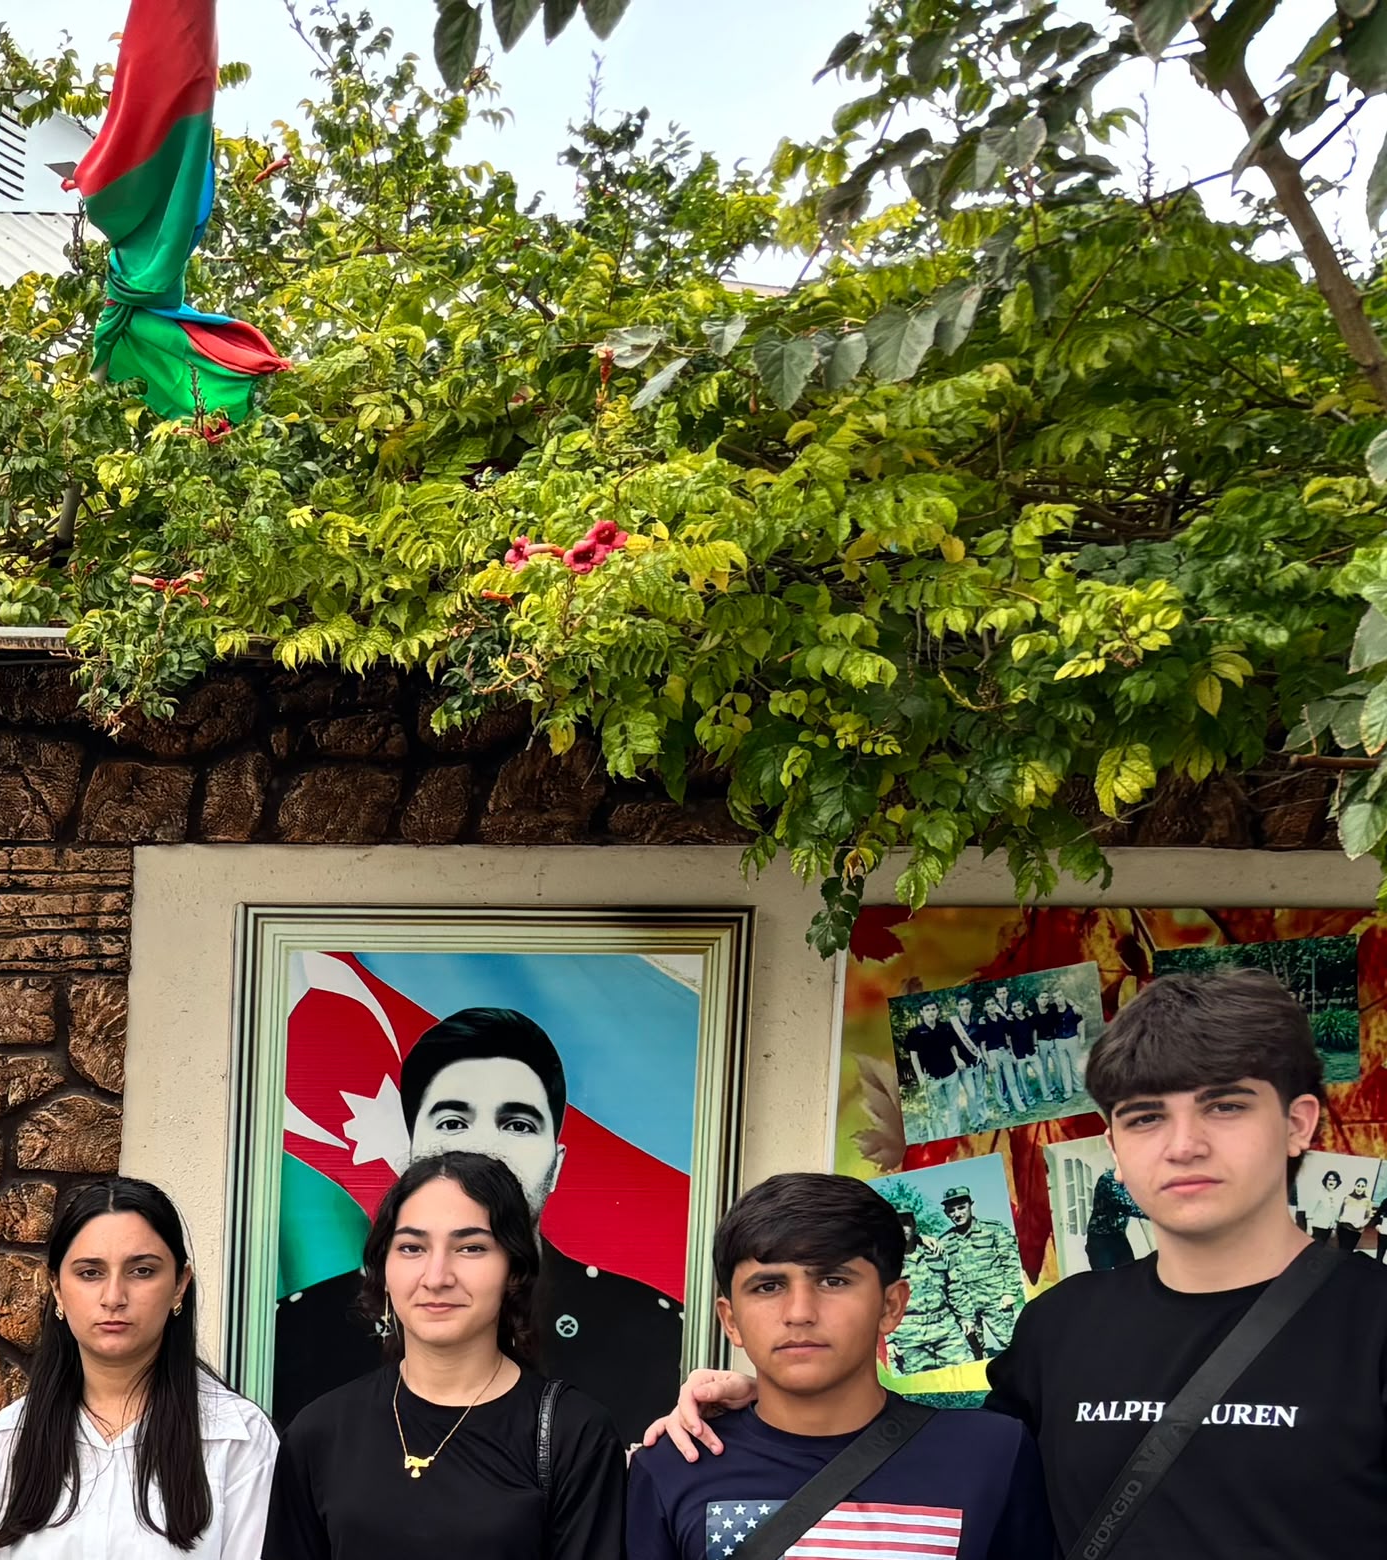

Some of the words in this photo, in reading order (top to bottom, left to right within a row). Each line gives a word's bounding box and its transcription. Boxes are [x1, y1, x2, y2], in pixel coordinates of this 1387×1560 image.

[1075, 1401, 1166, 1422] RALPH
[1201, 1403, 1299, 1428] UREN
[1083, 1479, 1144, 1560] GIORGIO
